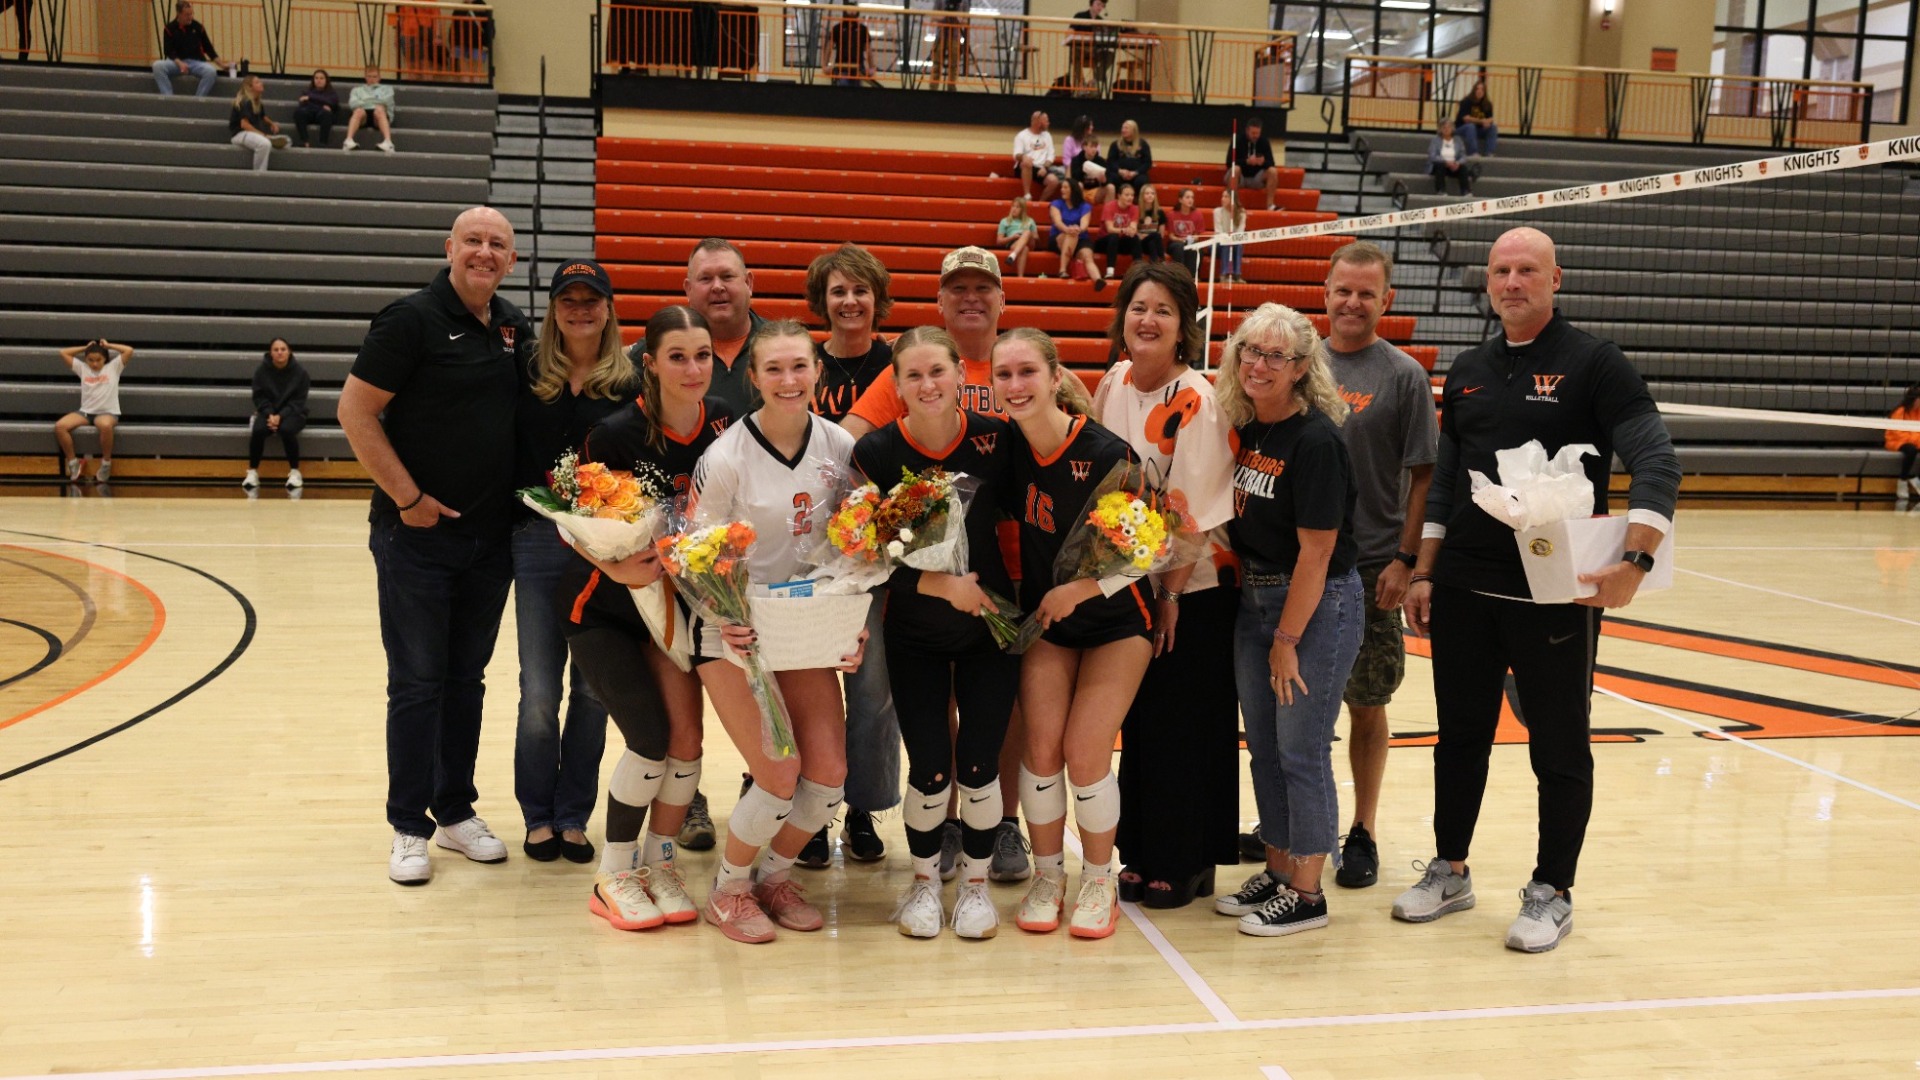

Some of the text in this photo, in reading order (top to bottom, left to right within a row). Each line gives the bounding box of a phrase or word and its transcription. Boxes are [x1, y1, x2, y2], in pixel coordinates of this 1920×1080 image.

[1289, 226, 1309, 235] KNIGHTS
[1323, 220, 1344, 231] KNIGHTS
[1359, 216, 1383, 227] KNIGHTS
[1400, 209, 1426, 221] KNIGHTS
[1445, 203, 1474, 216] KNIGHTS
[1496, 196, 1528, 209] KNIGHTS
[1553, 187, 1590, 202] KNIGHTS
[1619, 177, 1661, 193] KNIGHTS
[1695, 164, 1743, 184] KNIGHTS
[1784, 150, 1840, 171] KNIGHTS
[793, 492, 813, 537] 2
[1025, 483, 1057, 534] 16
